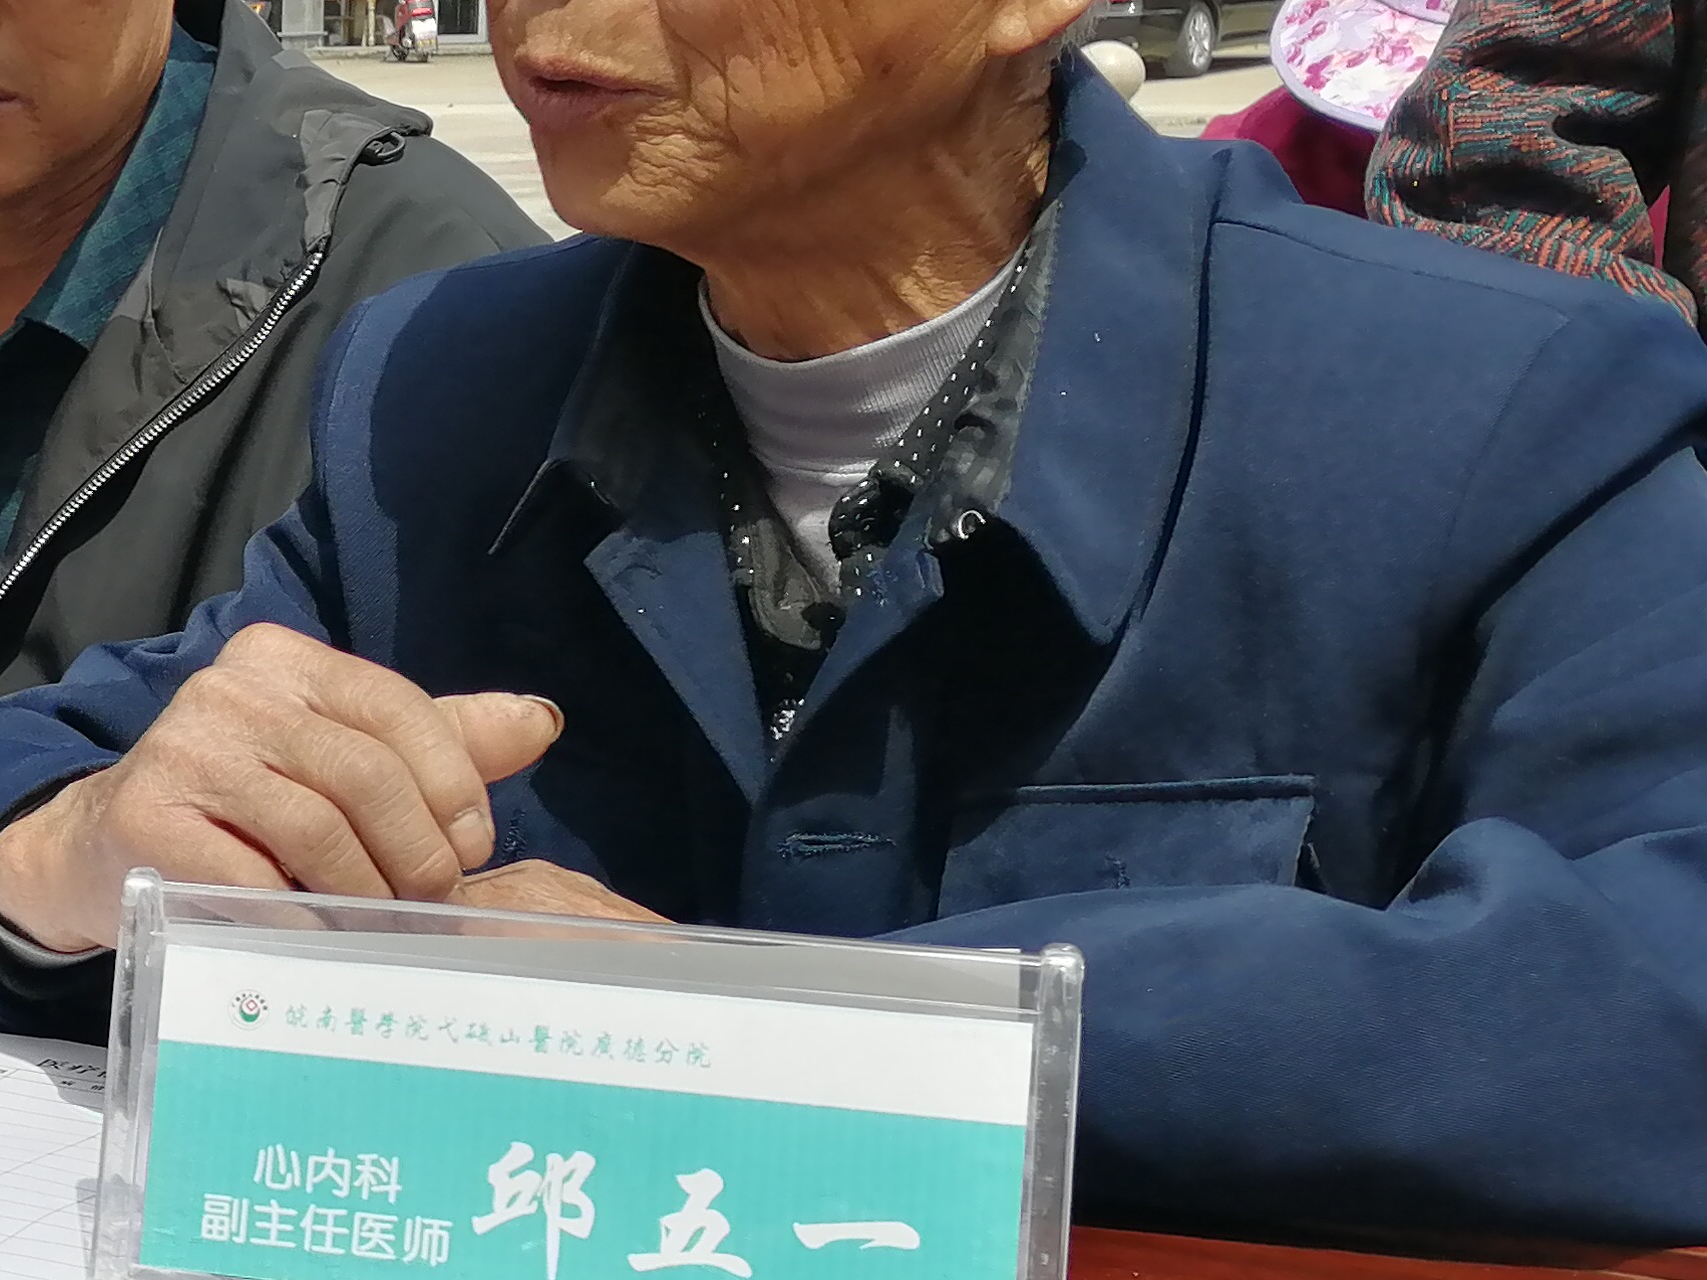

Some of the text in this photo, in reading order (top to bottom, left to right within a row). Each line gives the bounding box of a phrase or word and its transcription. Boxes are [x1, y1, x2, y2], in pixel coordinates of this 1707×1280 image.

[253, 1143, 403, 1205] 心内科
[200, 1192, 453, 1267] 副主任医师
